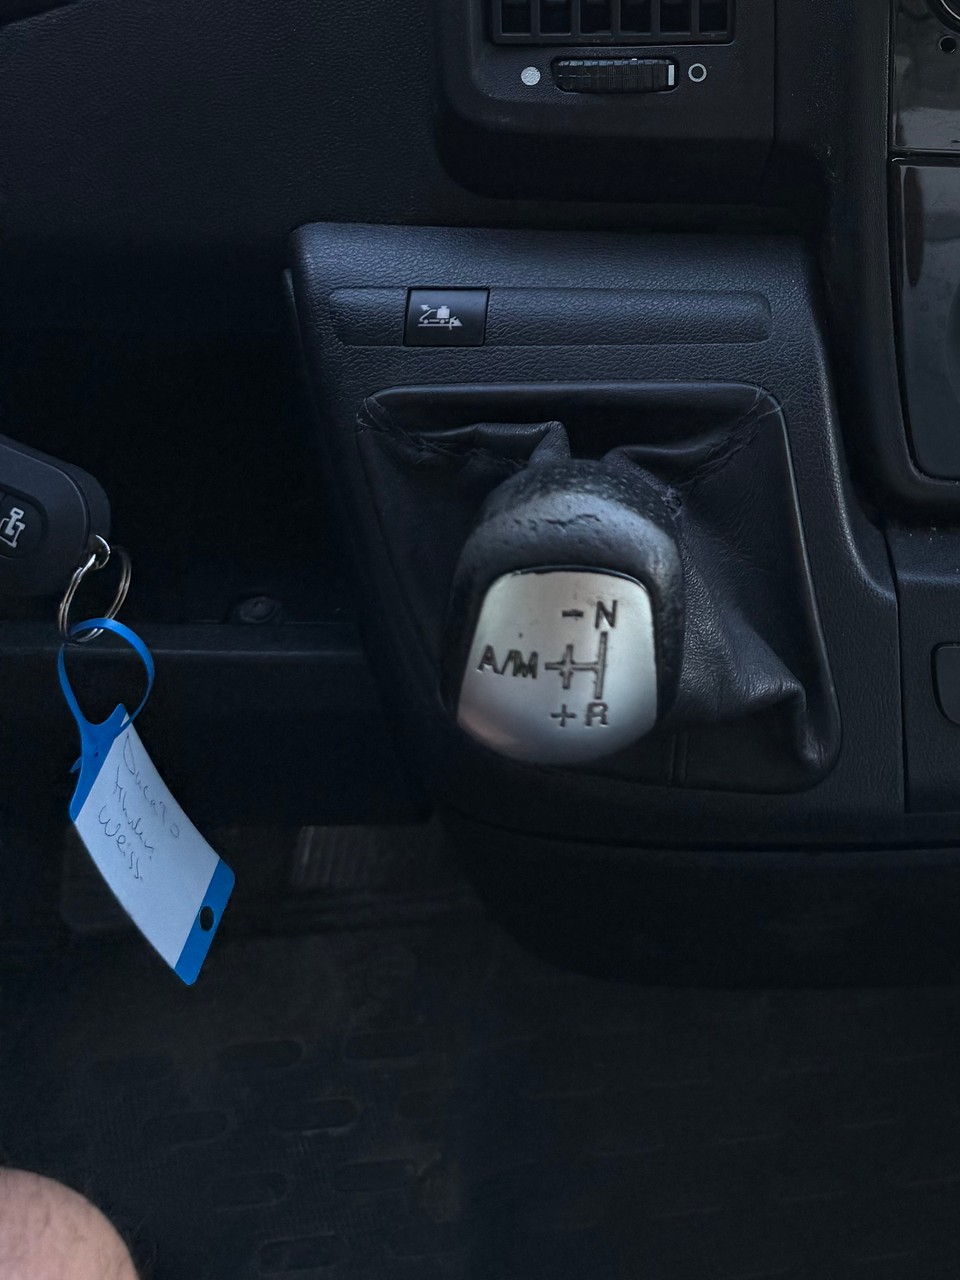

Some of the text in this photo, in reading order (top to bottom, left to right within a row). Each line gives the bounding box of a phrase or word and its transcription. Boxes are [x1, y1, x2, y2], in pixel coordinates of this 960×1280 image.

[595, 599, 618, 630] N
[477, 644, 539, 680] A/M
[585, 701, 610, 728] R
